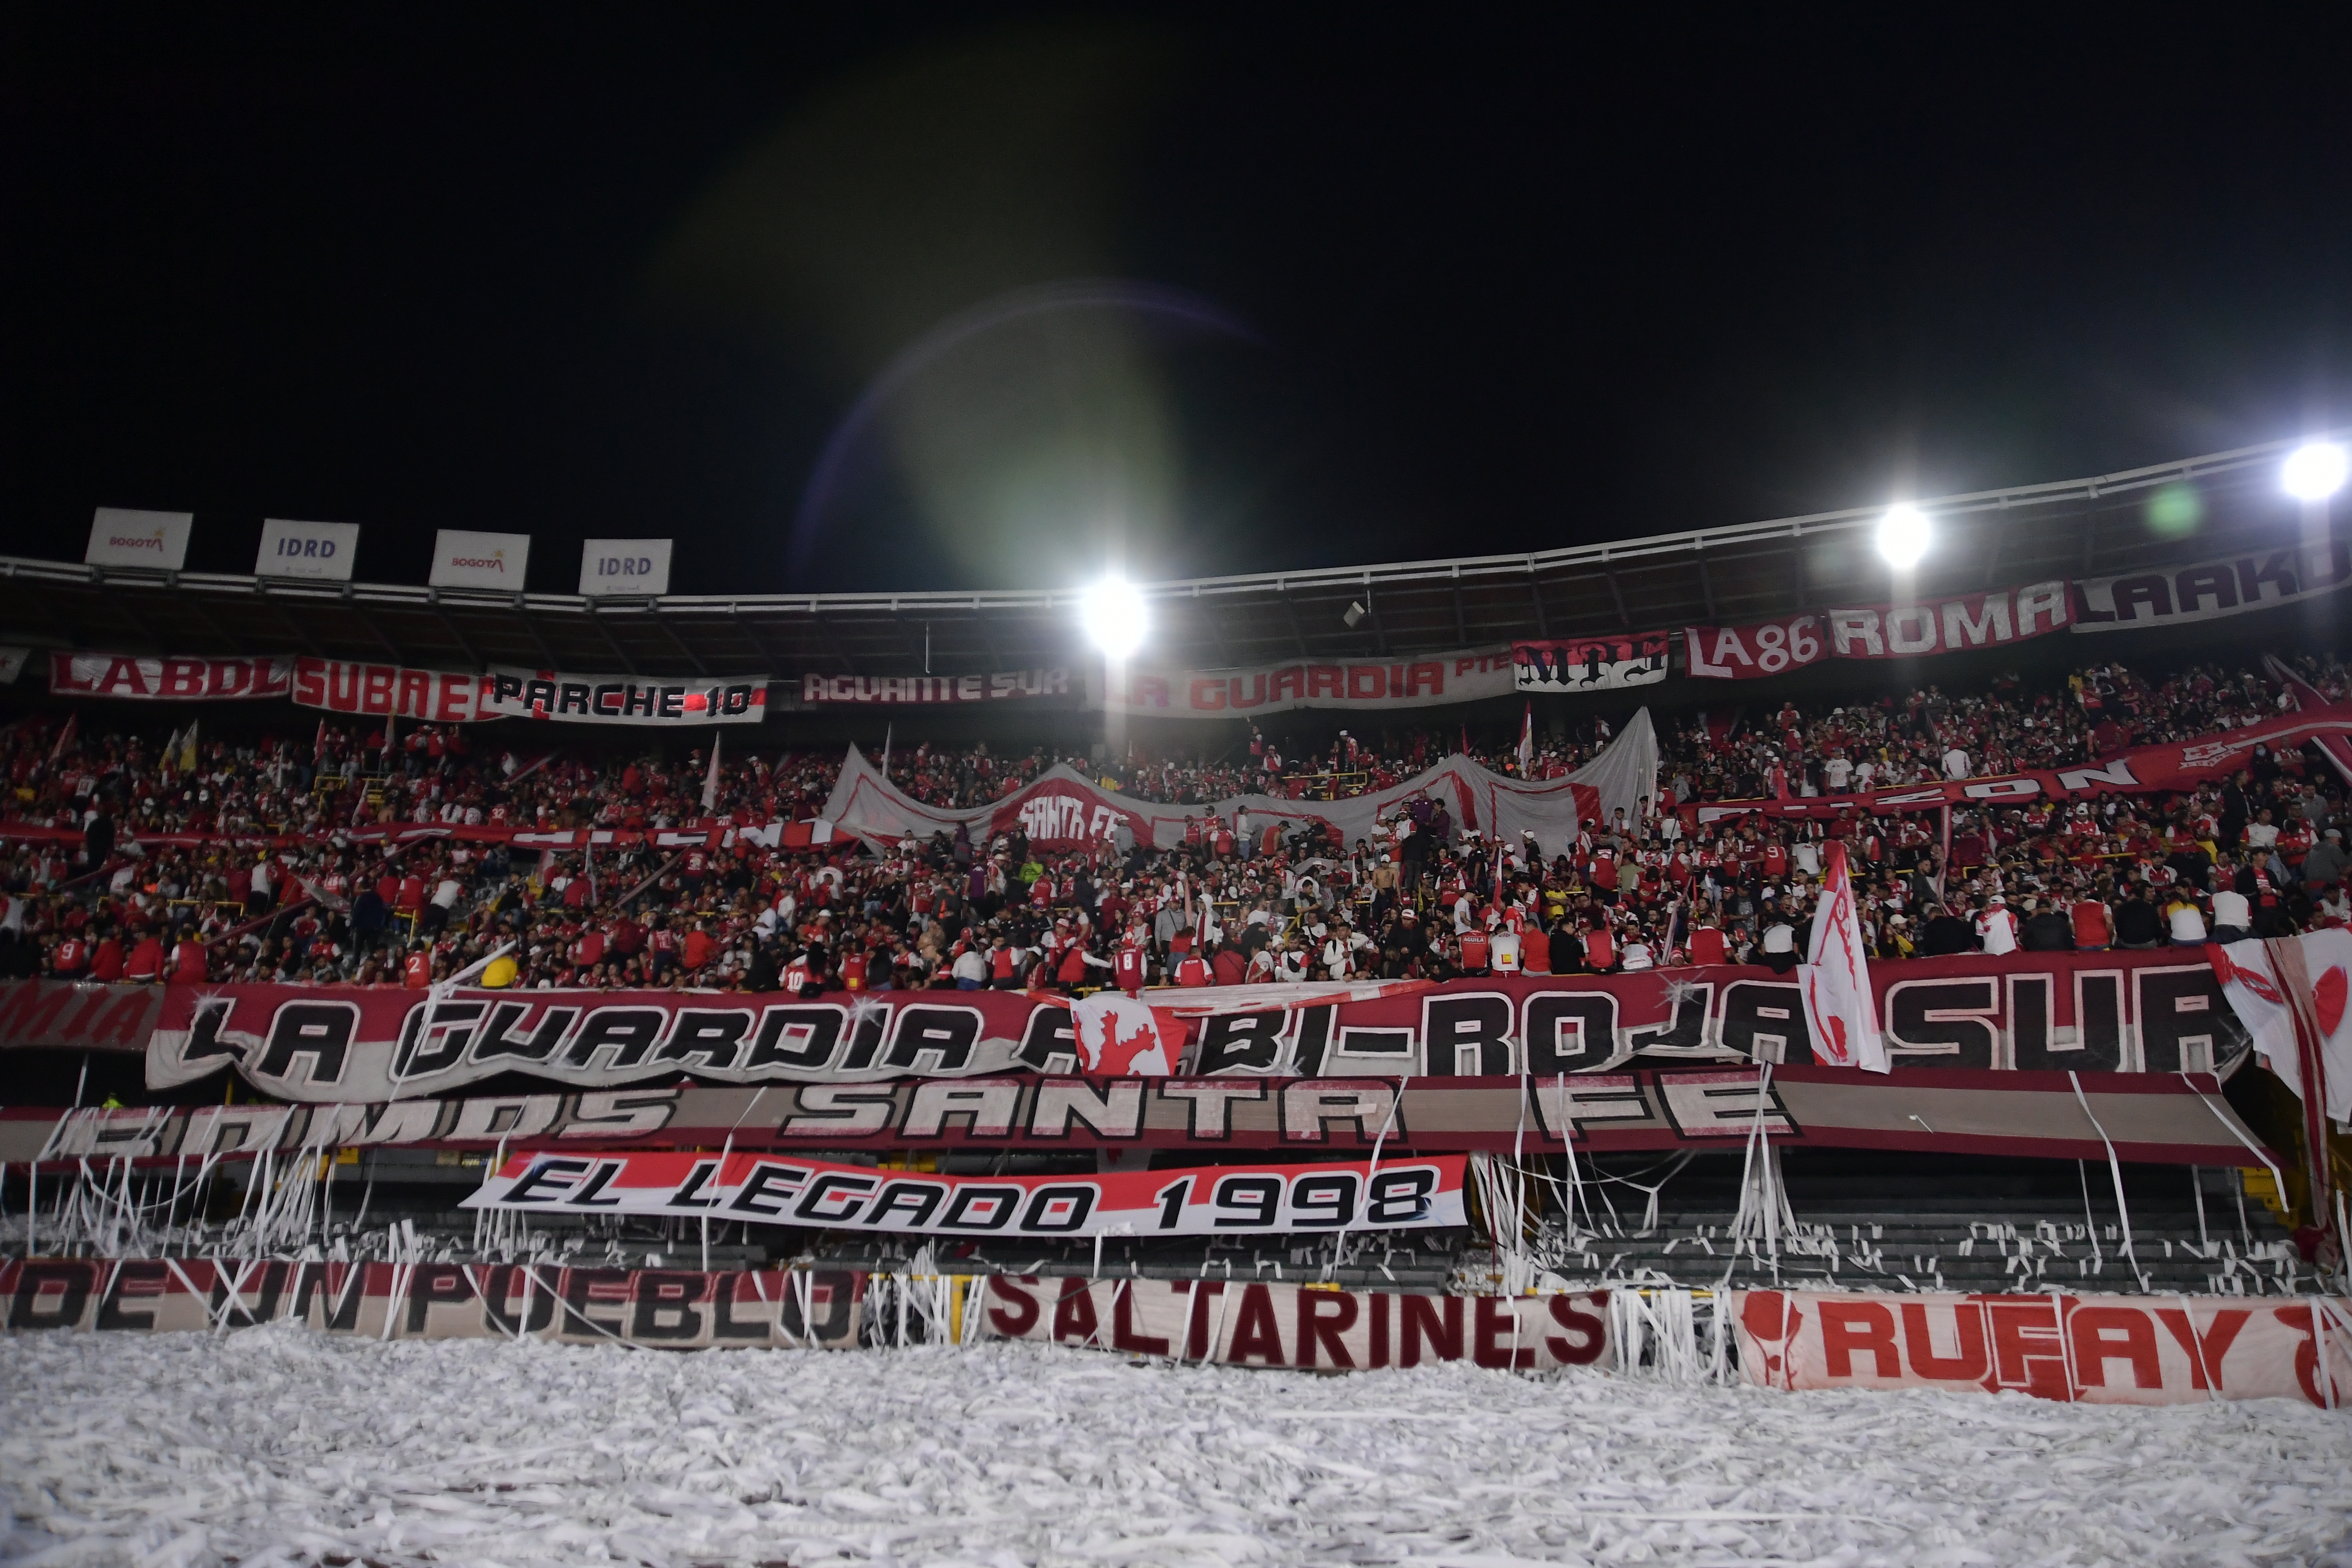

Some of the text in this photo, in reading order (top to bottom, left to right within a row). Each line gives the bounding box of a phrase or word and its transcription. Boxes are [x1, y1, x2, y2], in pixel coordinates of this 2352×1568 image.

[277, 538, 336, 558] IDRD
[598, 557, 651, 576] IDRD
[1829, 580, 2067, 655] ROMA
[493, 673, 752, 718] PARCHE 10
[804, 667, 1069, 701] AGUANTE SUR
[1190, 662, 1444, 710] GUARDIA
[1019, 795, 1086, 840] SANTA
[1767, 846, 1779, 858] 9
[61, 943, 75, 960] 9
[408, 956, 420, 973] 2
[1122, 953, 1133, 971] 8
[787, 972, 804, 991] 10
[0, 978, 154, 1045] MIA
[180, 996, 361, 1086] LA
[388, 998, 984, 1082] GUARDIA
[776, 1075, 1409, 1144] SANTA
[1525, 1069, 1804, 1143] FE
[500, 1154, 1440, 1233] EL LEGADO 1998
[6, 1260, 862, 1348] DE UN PUEBLO
[988, 1275, 1612, 1369] SALTARINES
[1817, 1299, 2252, 1391] RUFAY
